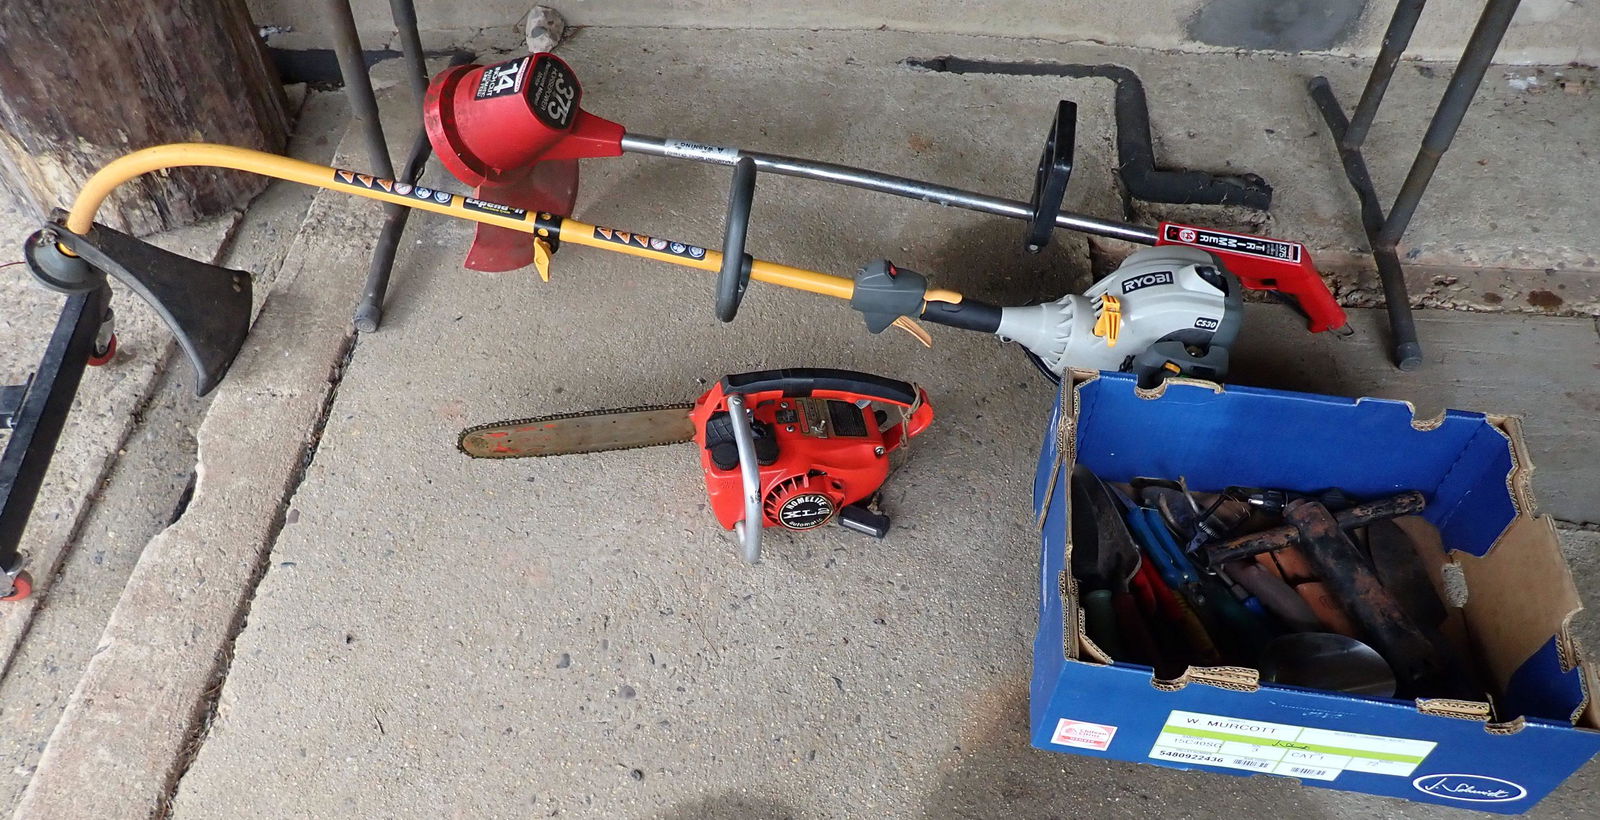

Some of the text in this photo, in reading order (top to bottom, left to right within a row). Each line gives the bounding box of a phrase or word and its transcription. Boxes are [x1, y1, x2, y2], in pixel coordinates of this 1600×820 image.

[485, 66, 502, 97] INCH CUT
[494, 62, 519, 94] 14
[547, 71, 575, 125] .375
[680, 142, 714, 153] WARNING
[1199, 233, 1266, 252] TRIMMER
[1124, 272, 1172, 292] RYOBI
[1195, 318, 1217, 330] CS30
[785, 496, 828, 510] HOMELITE
[788, 517, 824, 528] automatic
[1186, 717, 1203, 726] W.
[1207, 720, 1279, 735] MURCOTT
[1159, 749, 1224, 763] 5480922436
[1290, 751, 1317, 760] CAT
[1441, 781, 1510, 798] Schmidt
